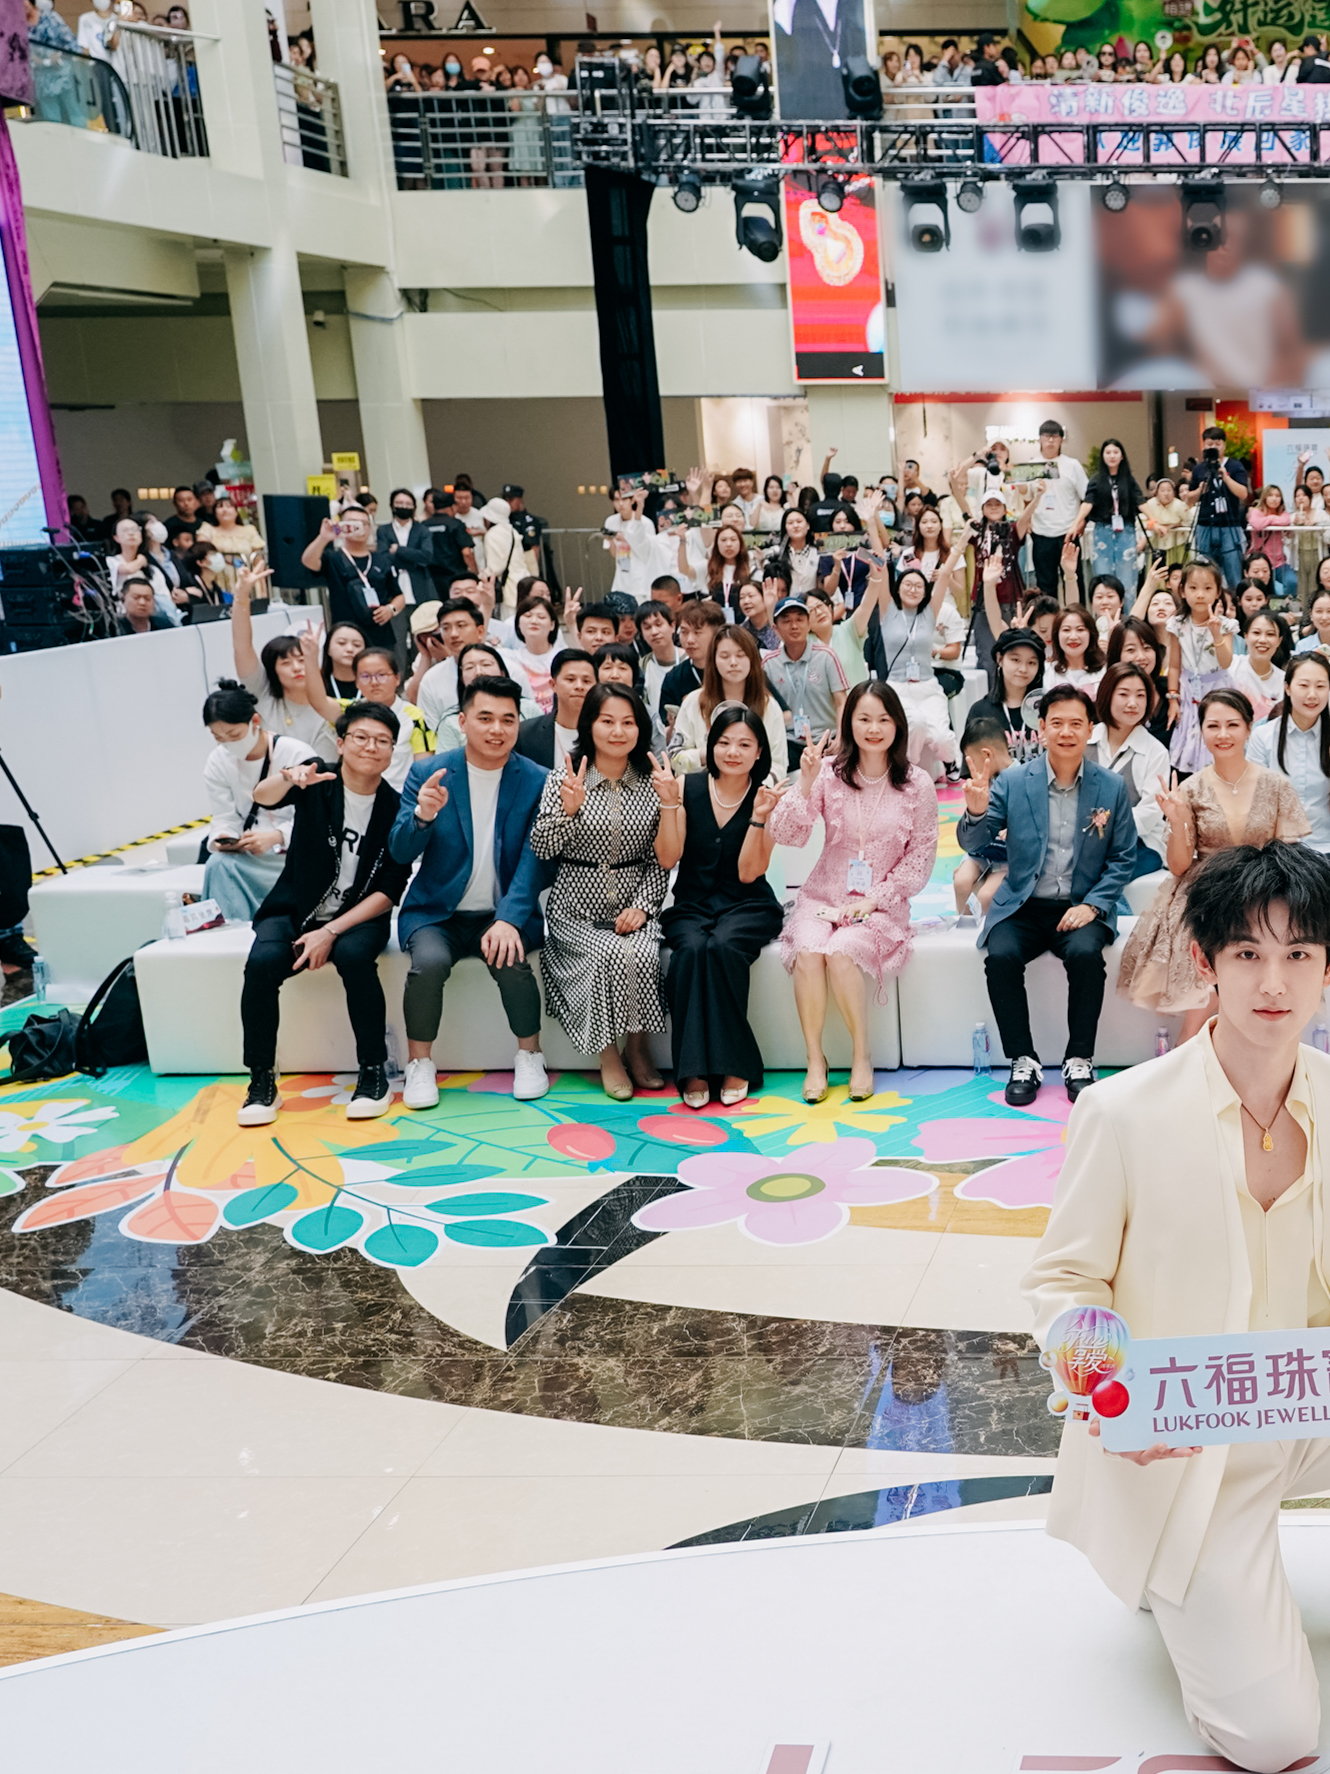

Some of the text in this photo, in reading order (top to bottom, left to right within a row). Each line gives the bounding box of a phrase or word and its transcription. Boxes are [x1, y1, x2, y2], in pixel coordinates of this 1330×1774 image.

[379, 0, 495, 33] RA
[1049, 87, 1187, 118] 清新俊逸
[1152, 1411, 1252, 1433] LUKFOOK
